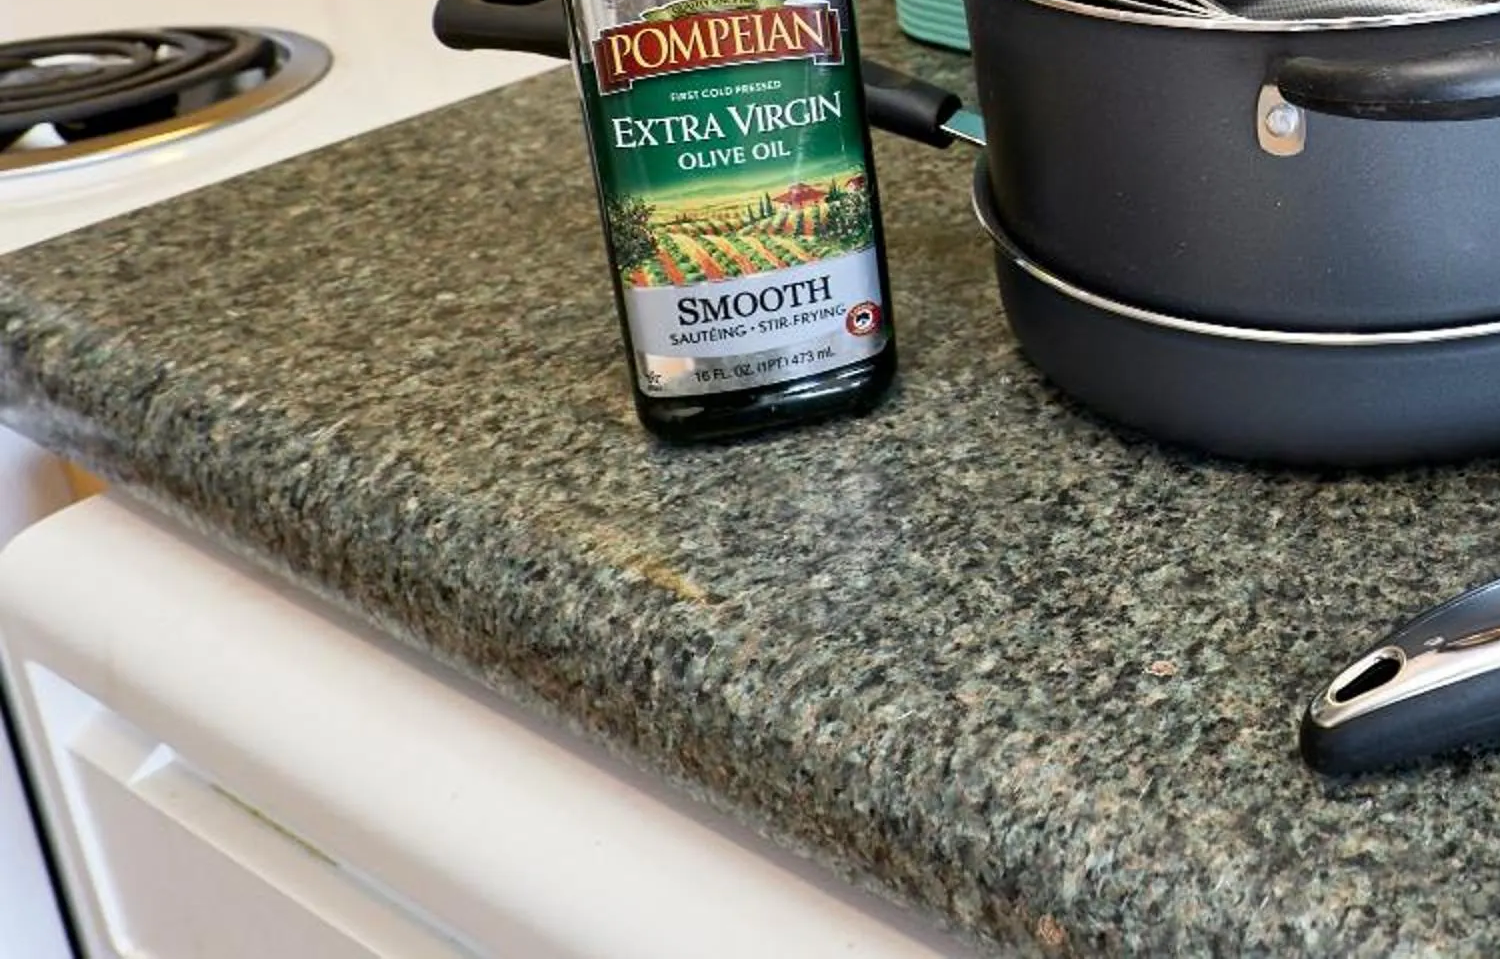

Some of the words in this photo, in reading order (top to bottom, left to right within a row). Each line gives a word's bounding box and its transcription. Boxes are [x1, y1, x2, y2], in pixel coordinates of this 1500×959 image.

[608, 9, 826, 76] POMPEIAN
[670, 90, 699, 102] FIRST
[701, 86, 733, 98] COLD
[735, 80, 782, 94] PRESSED
[611, 112, 726, 149] EXTRA
[727, 91, 842, 136] VIRGIN
[677, 148, 746, 170] OLIVE
[752, 140, 791, 161] OIL
[677, 274, 832, 326] SMOOTH
[669, 323, 747, 346] SAUTÉING
[757, 303, 847, 334] STIR-FRYING
[694, 370, 711, 383] 16
[791, 350, 815, 365] 473
